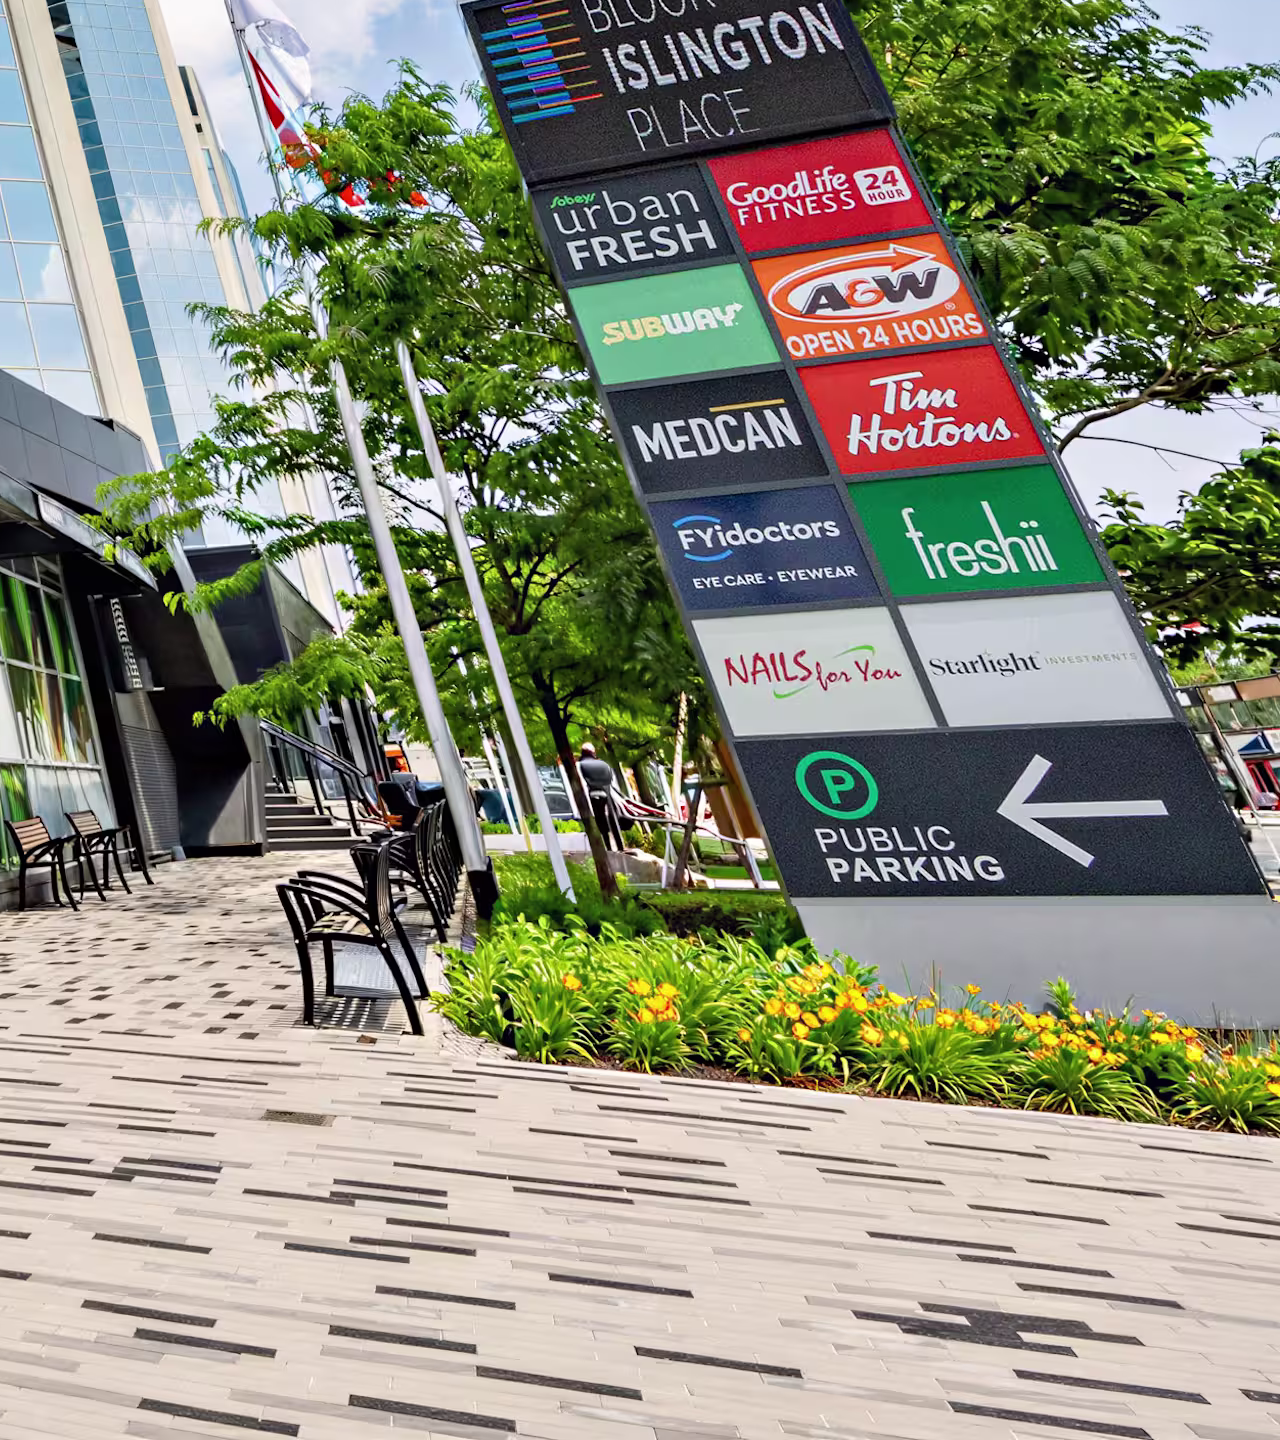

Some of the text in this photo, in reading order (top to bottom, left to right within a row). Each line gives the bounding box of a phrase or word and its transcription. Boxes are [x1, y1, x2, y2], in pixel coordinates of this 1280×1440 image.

[601, 2, 845, 95] ISLINGTON
[627, 88, 760, 152] PLACE
[726, 165, 850, 207] GoodLife
[863, 170, 899, 192] 24
[867, 188, 906, 203] HOUR
[553, 189, 700, 235] urban
[738, 190, 856, 227] FITNESS
[566, 219, 718, 271] FRESH
[800, 267, 941, 317] A&W
[601, 302, 744, 346] SUBWAY
[785, 312, 985, 358] OPEN 24 HOURS
[869, 371, 958, 416] Tim
[631, 407, 804, 464] MEDCAN
[846, 412, 1013, 456] Hortons
[679, 517, 841, 553] FYidoctors
[900, 500, 1059, 580] freshii
[692, 565, 859, 590] EYE CARE EYEWEAR
[724, 648, 903, 692] NAILS for You
[929, 651, 1138, 678] Starlight INVESTMENTS
[813, 825, 956, 854] PUBLIC
[824, 854, 1005, 884] PARKING
